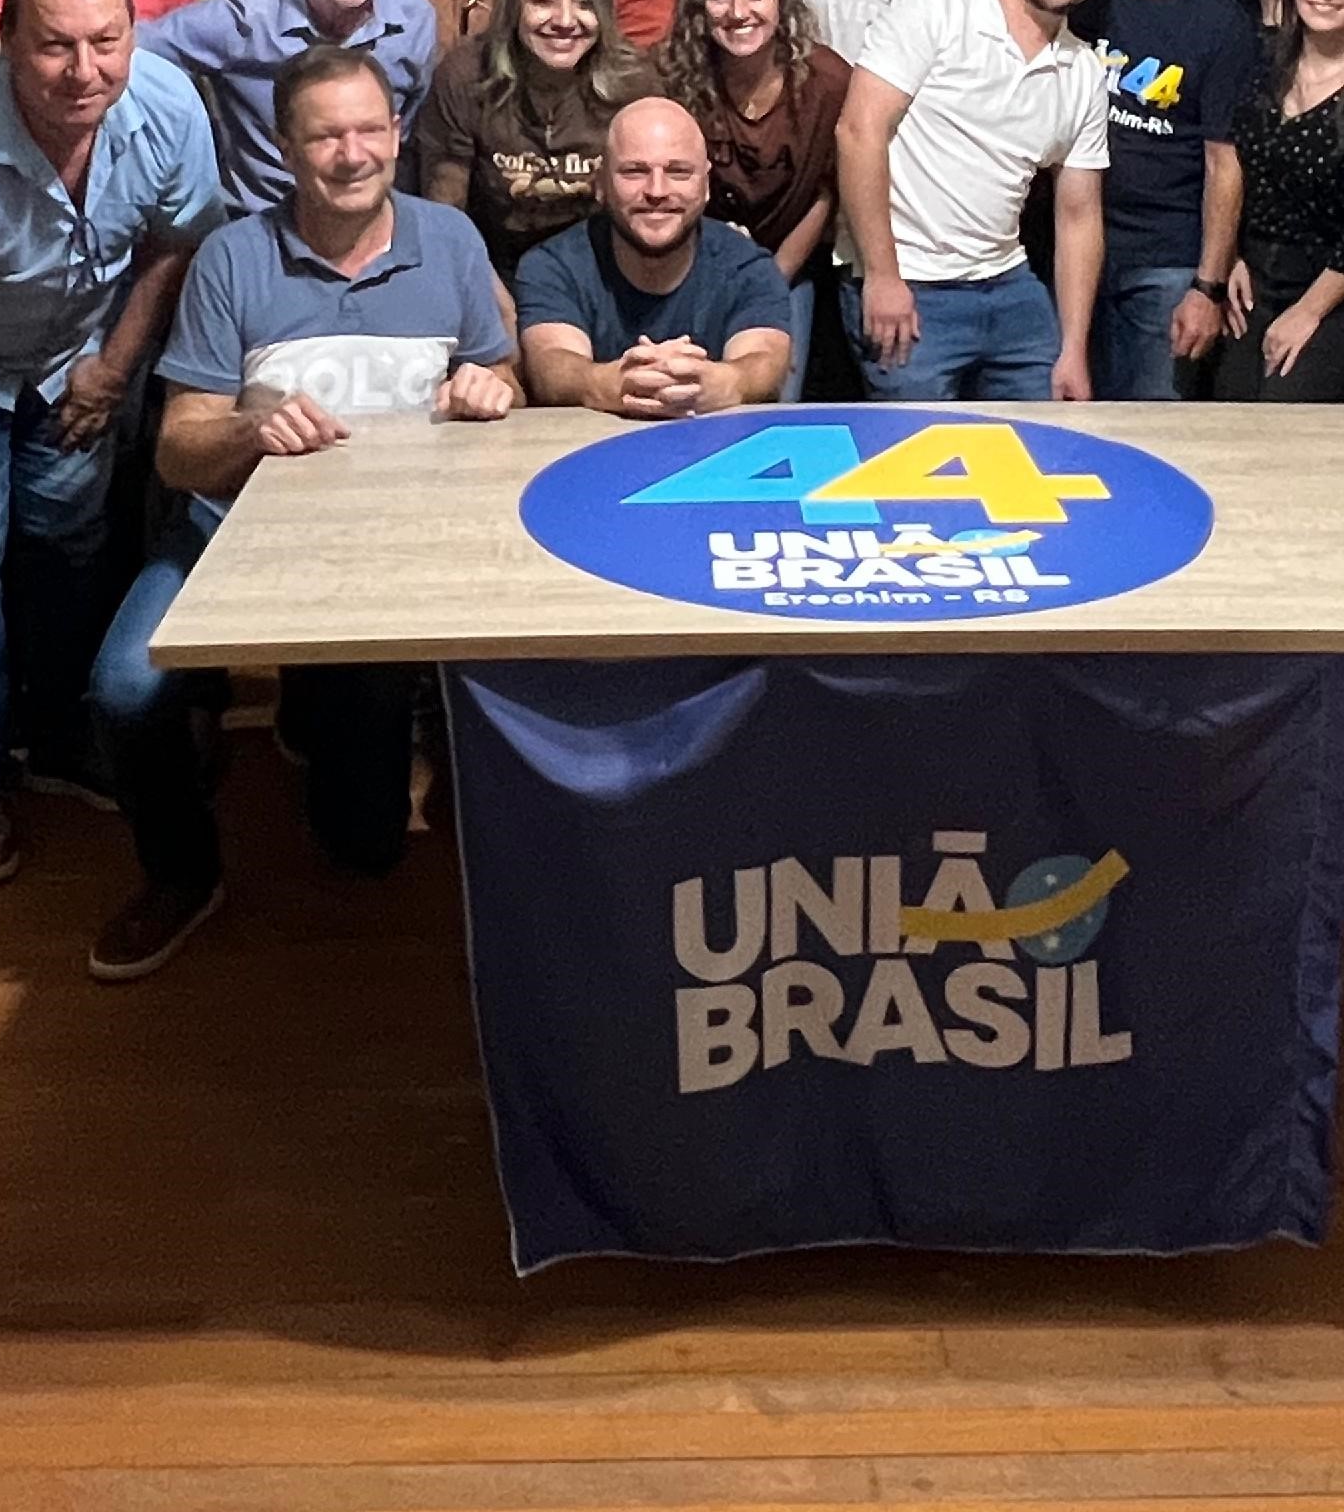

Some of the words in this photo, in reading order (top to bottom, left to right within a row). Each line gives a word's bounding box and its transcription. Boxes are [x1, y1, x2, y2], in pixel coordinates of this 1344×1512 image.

[1119, 56, 1185, 109] 44
[620, 424, 1112, 525] 44
[709, 523, 1043, 559] UNIÃO
[711, 556, 1071, 589] BRASIL
[672, 830, 1131, 984] UNIÃO
[674, 957, 1133, 1095] BRASIL
